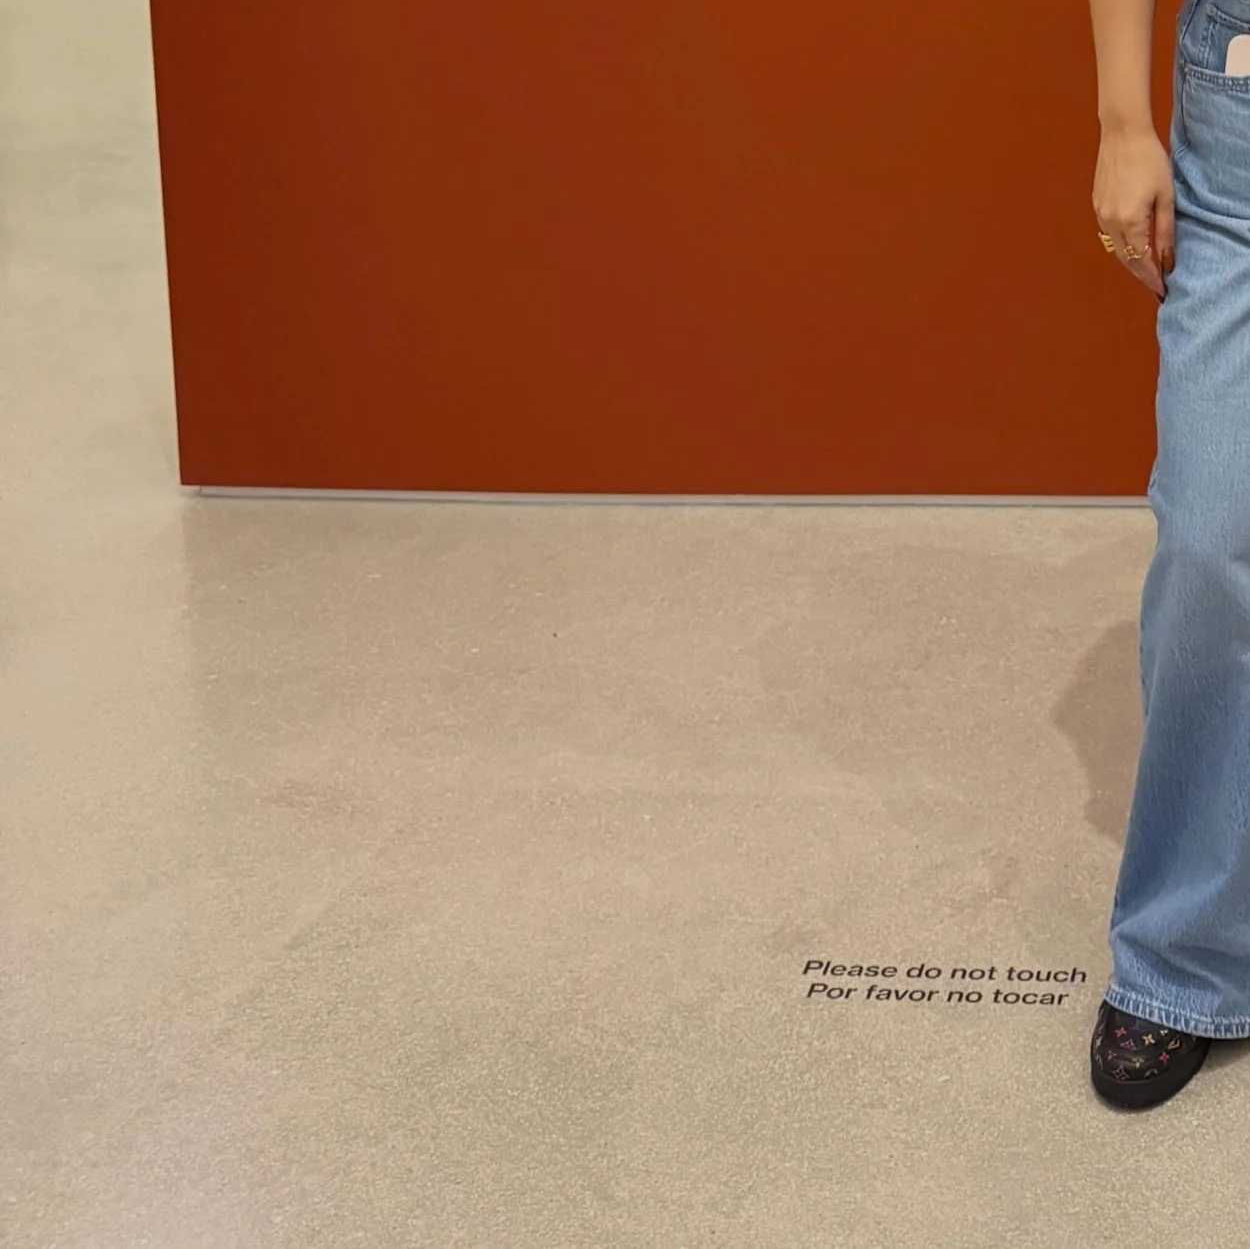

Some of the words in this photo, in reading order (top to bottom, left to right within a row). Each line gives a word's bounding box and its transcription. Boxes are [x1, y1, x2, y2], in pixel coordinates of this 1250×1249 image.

[802, 959, 898, 979] Please
[906, 963, 942, 980] do
[950, 965, 996, 982] not
[1006, 966, 1087, 984] touch
[806, 982, 858, 1000] Por
[865, 984, 939, 1002] favor
[947, 988, 982, 1004] no
[993, 989, 1069, 1006] tocar
